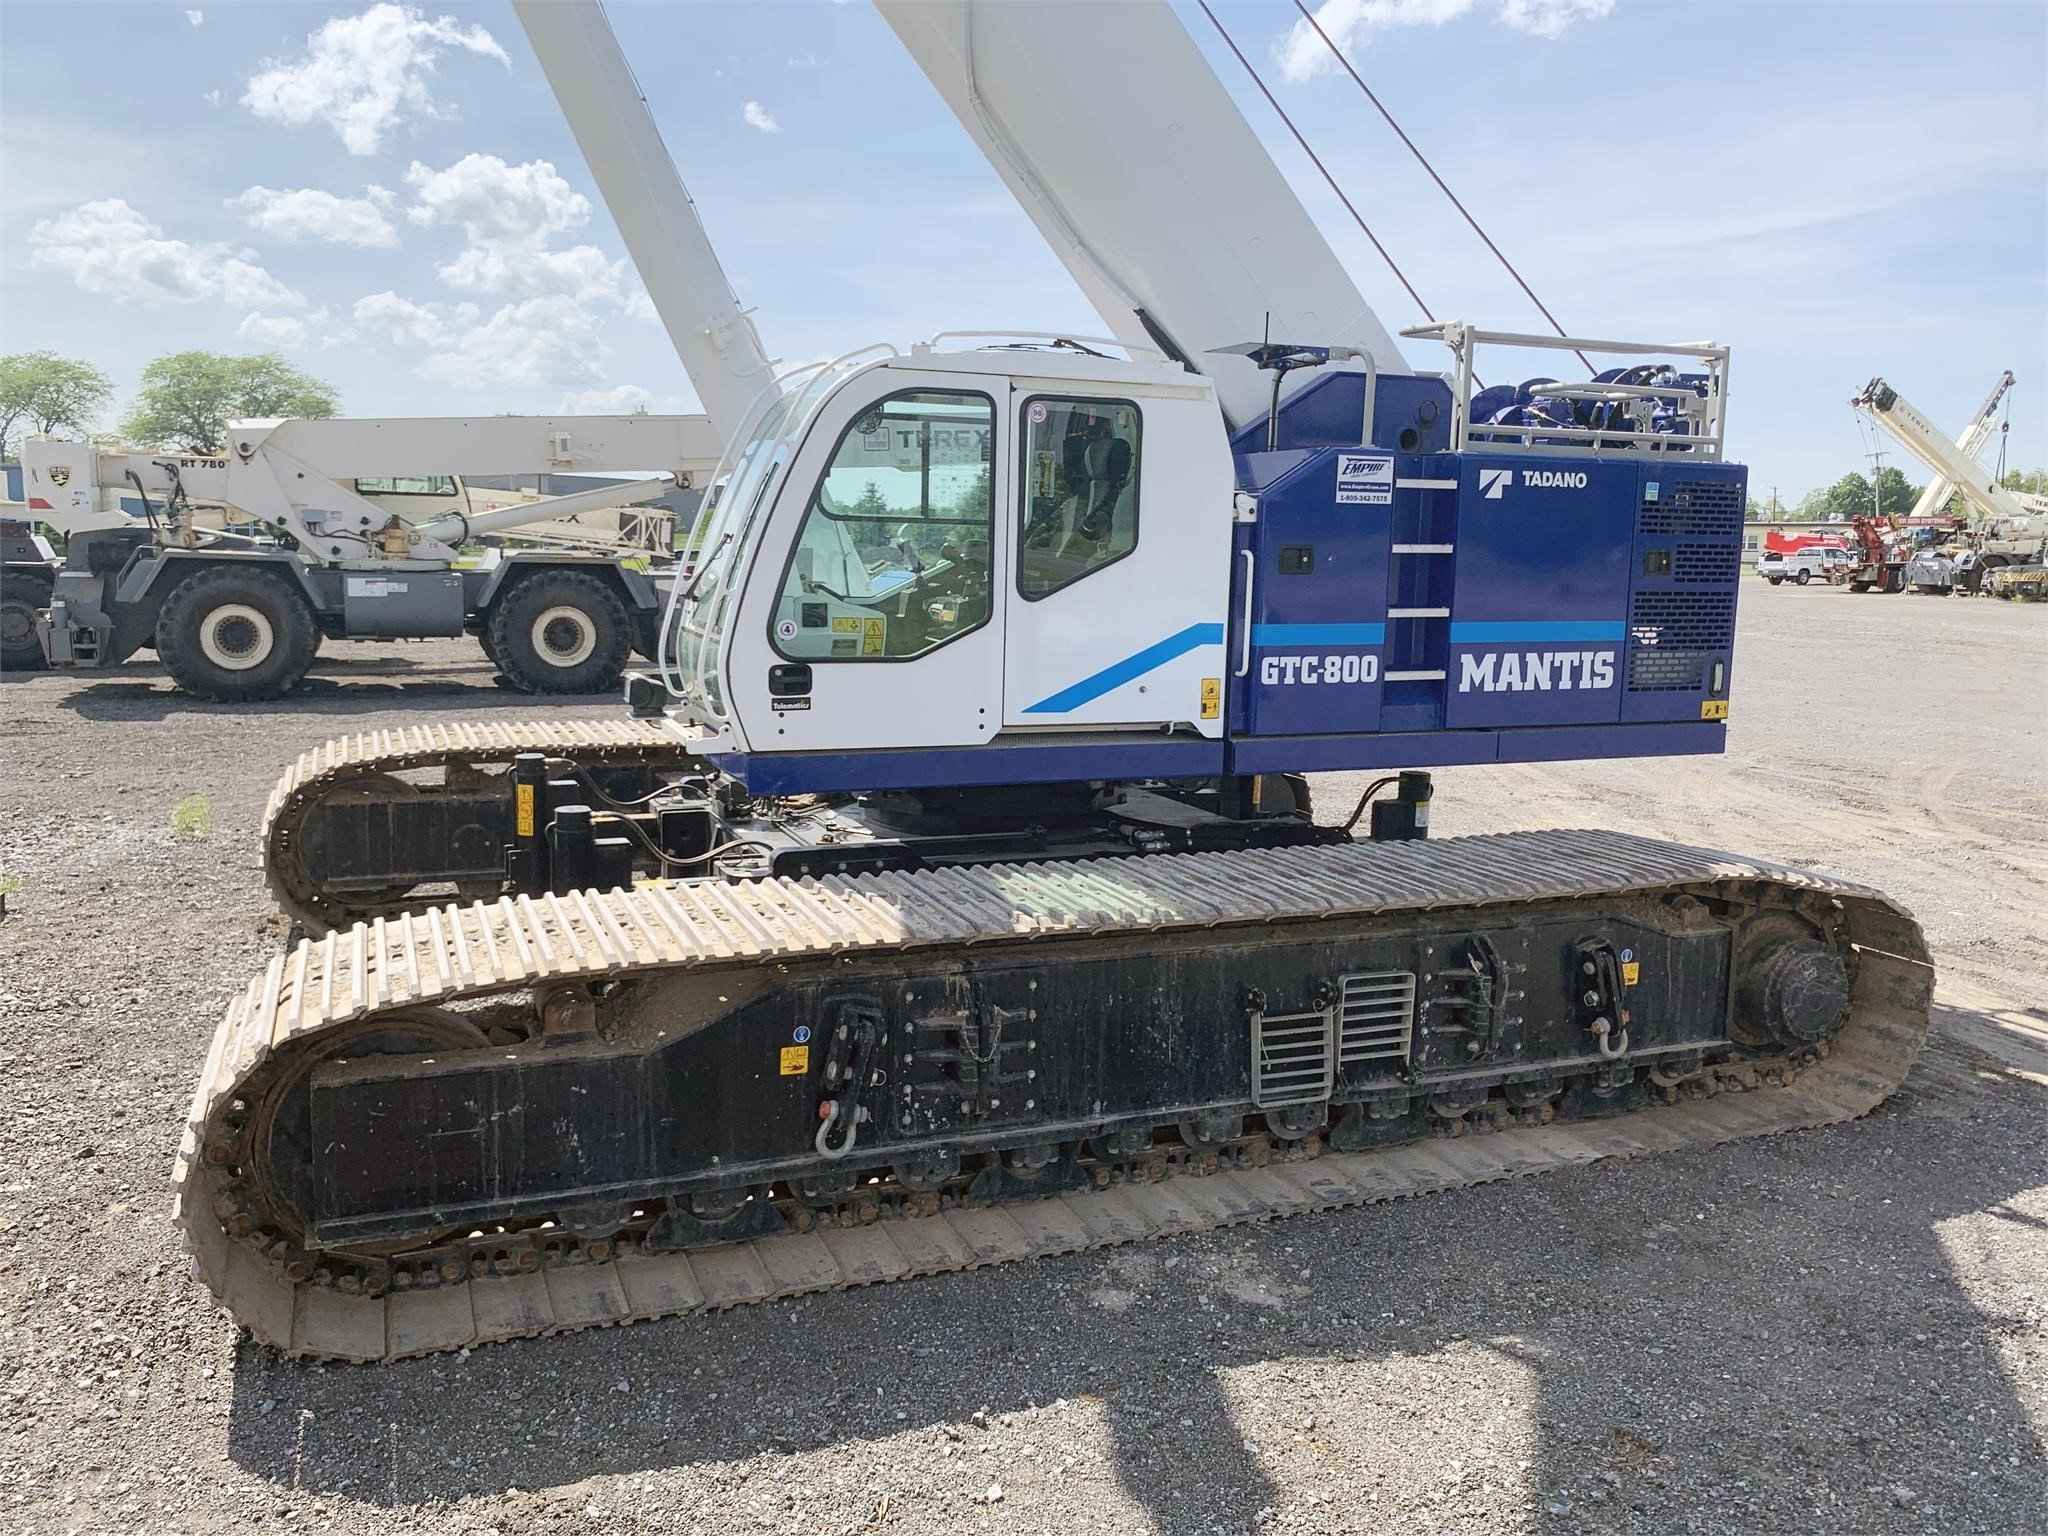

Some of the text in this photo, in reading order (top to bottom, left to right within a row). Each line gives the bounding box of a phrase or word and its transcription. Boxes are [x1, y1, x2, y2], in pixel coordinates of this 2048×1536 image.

[180, 459, 225, 469] RT 780
[1522, 470, 1588, 489] TADANO
[1261, 651, 1616, 692] GTC-800 MANTIS
